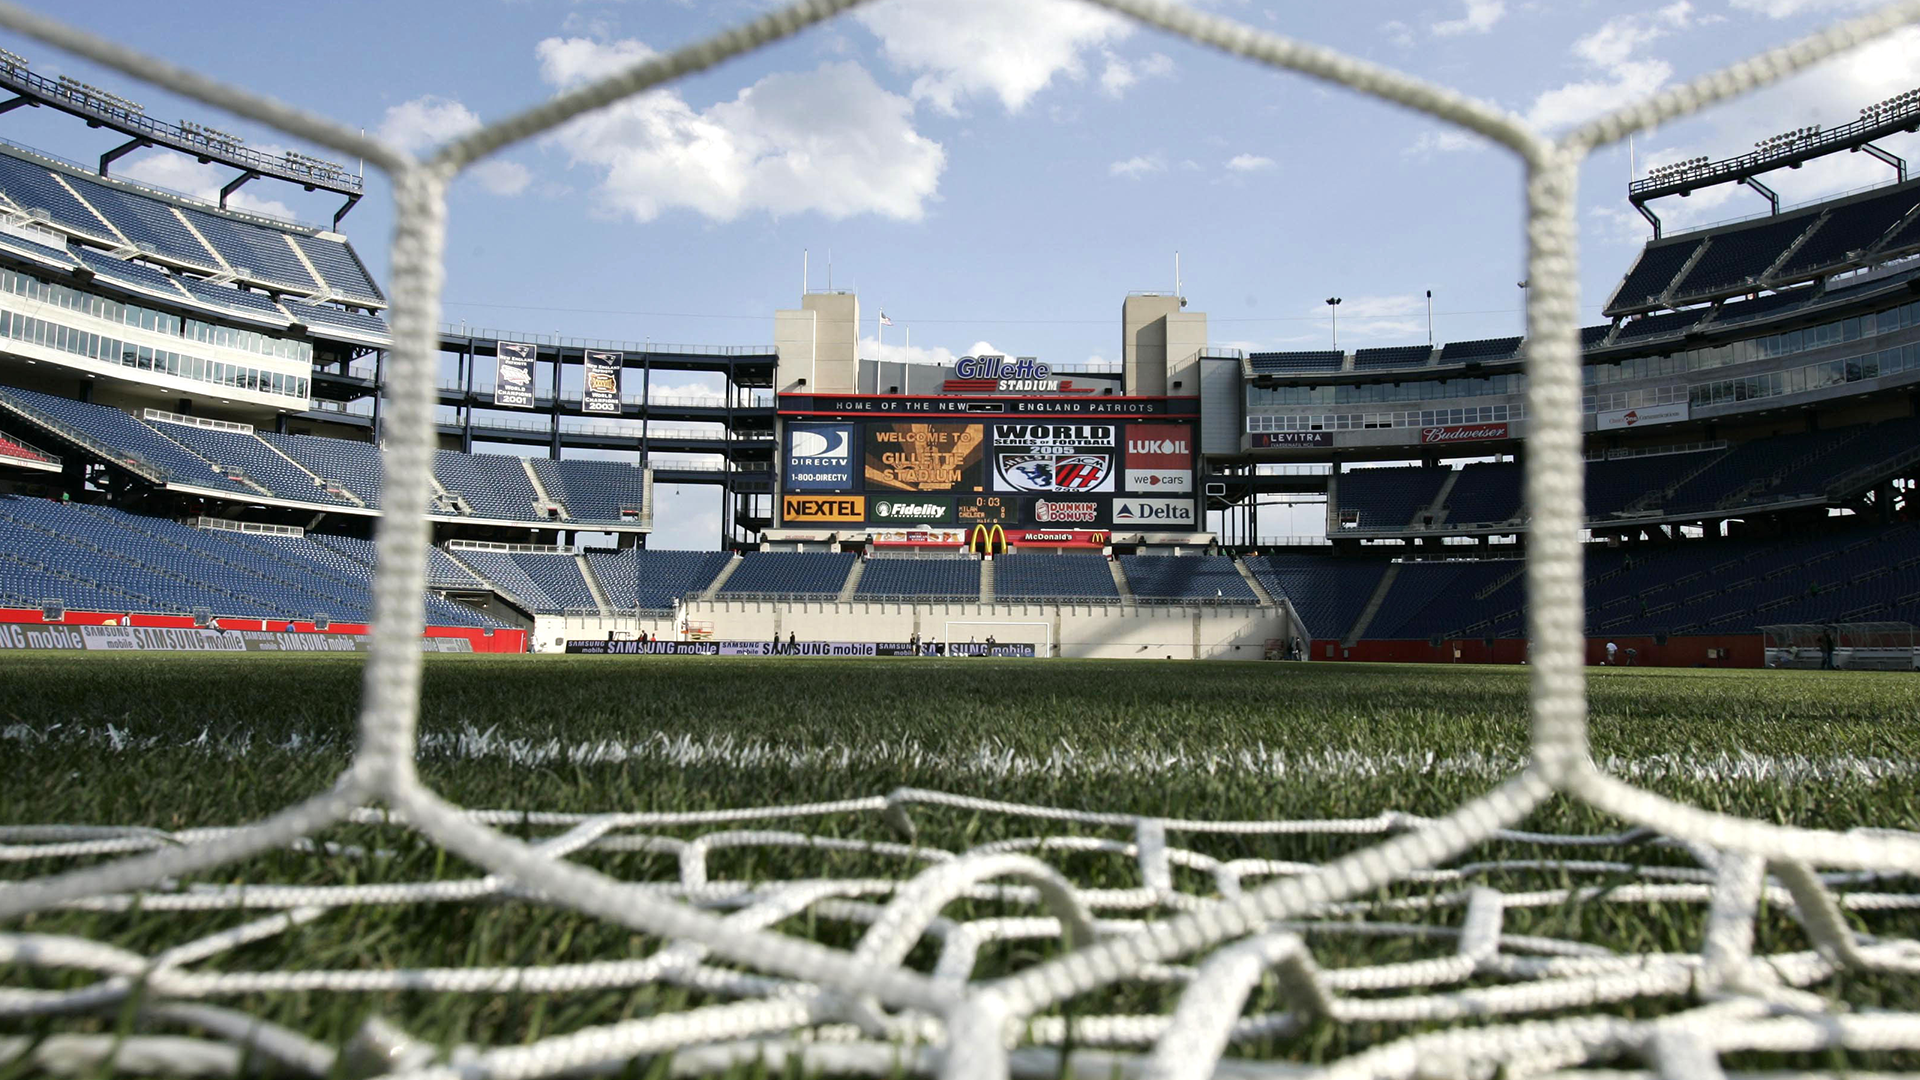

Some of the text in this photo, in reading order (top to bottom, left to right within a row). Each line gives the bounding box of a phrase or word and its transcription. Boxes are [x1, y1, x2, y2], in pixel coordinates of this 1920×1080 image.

[956, 356, 1049, 379] Gillette
[999, 380, 1058, 391] STADIUM
[498, 389, 532, 398] CHAMPIONS
[503, 396, 527, 404] 2001
[589, 403, 614, 411] 2003
[836, 402, 1153, 412] HOME OF THE NEW ENGLAND PATRIOTS
[876, 432, 972, 442] WELCOME TO
[995, 425, 1111, 439] WORLD
[1270, 433, 1322, 442] LEVITRA
[1423, 427, 1505, 442] Budweiser
[1030, 446, 1075, 454] 2005
[1129, 439, 1189, 454] LUKOIL
[882, 452, 964, 465] GILLETTE
[1066, 457, 1103, 468] ACM
[792, 473, 848, 482] 1-800-DIRECTV
[883, 469, 962, 482] STADIUM
[1134, 476, 1183, 484] we cars
[976, 497, 1000, 507] 0:03
[1050, 502, 1097, 512] DUNKIN'
[786, 501, 861, 516] NEXTEL
[891, 503, 946, 518] Fidelity
[1138, 503, 1191, 518] Delta
[1050, 511, 1096, 521] DONUTS
[26, 625, 82, 649] mobile
[84, 626, 130, 637] SAMSUNG
[243, 631, 275, 640] SAMSUNG
[107, 639, 134, 649] mobile
[133, 628, 206, 650] SAMSUNG
[276, 632, 329, 651] SAMSUNG
[328, 634, 356, 651] mobile
[607, 641, 717, 655] SAMSUNG mobile
[833, 643, 873, 655] mobile
[991, 644, 1032, 656] mobile
